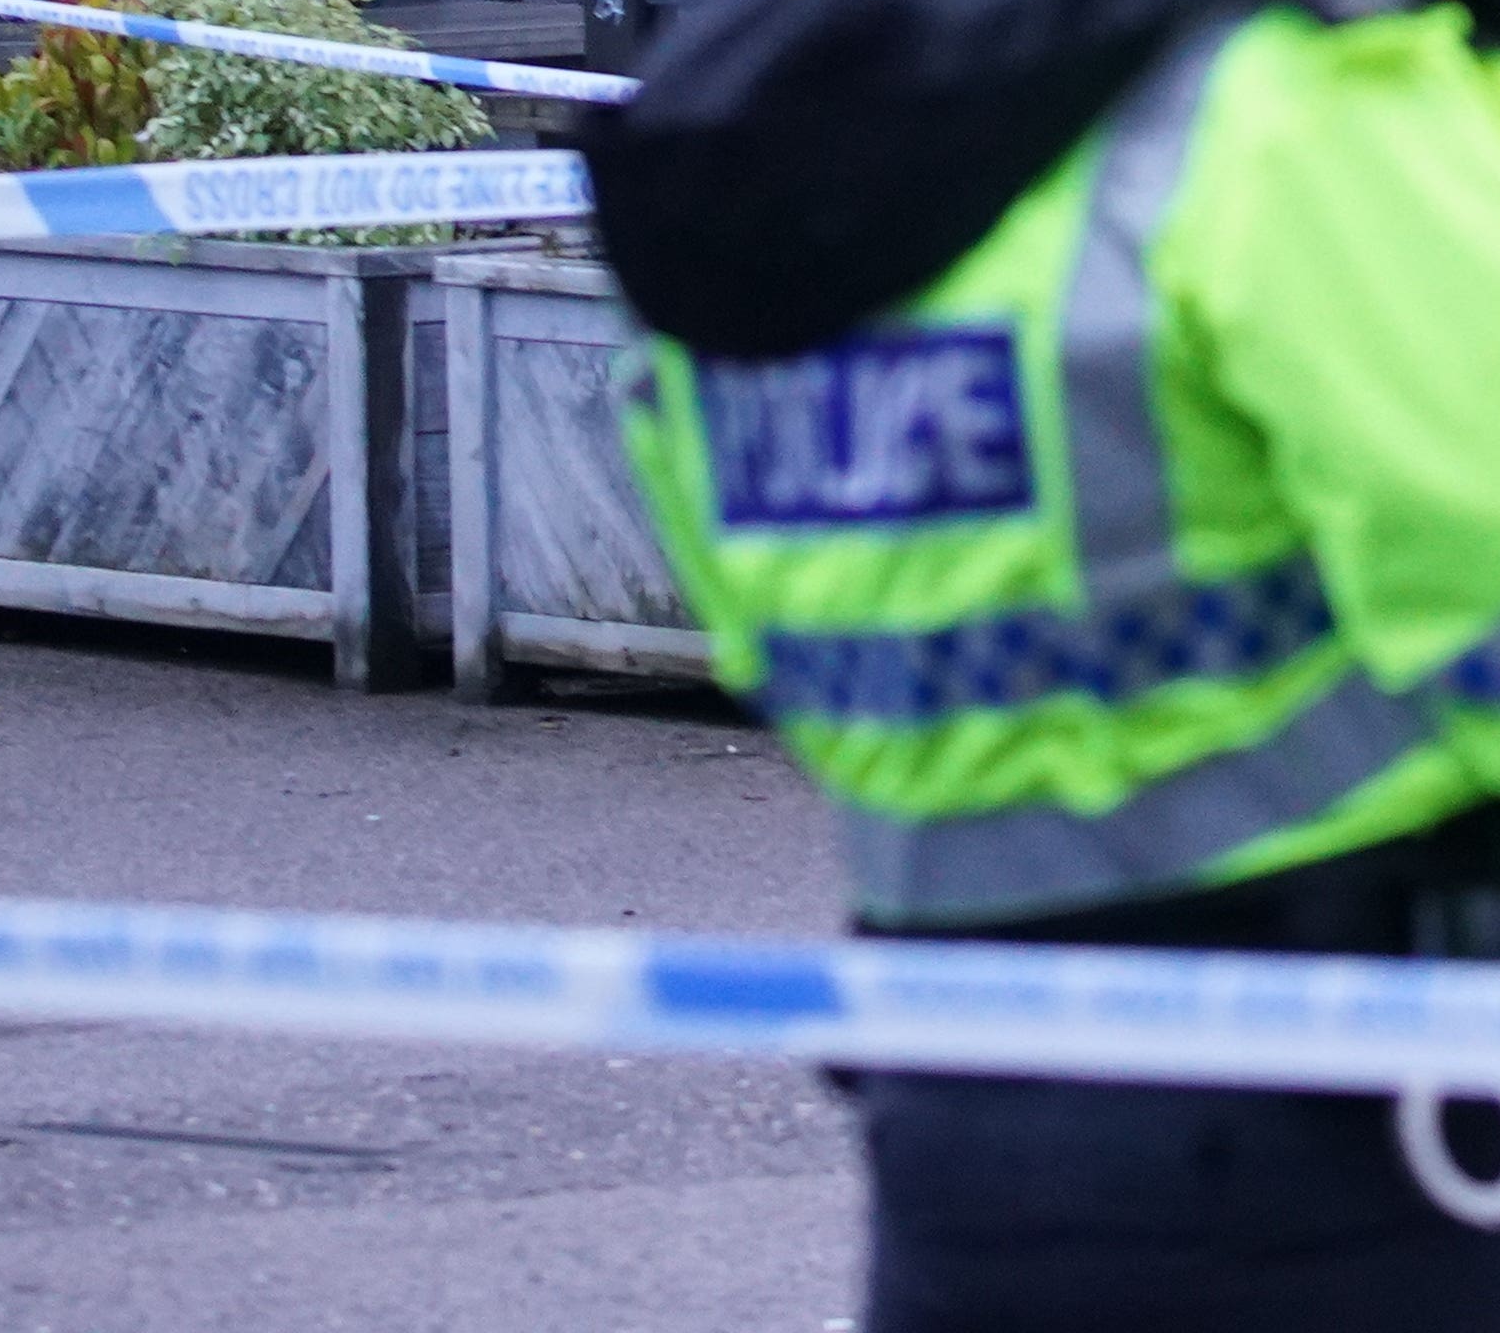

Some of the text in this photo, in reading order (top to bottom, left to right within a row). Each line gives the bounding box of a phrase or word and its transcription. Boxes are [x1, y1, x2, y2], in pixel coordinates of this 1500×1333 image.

[184, 170, 300, 223] CROSS
[312, 168, 380, 215] NOT
[387, 167, 439, 211] DO
